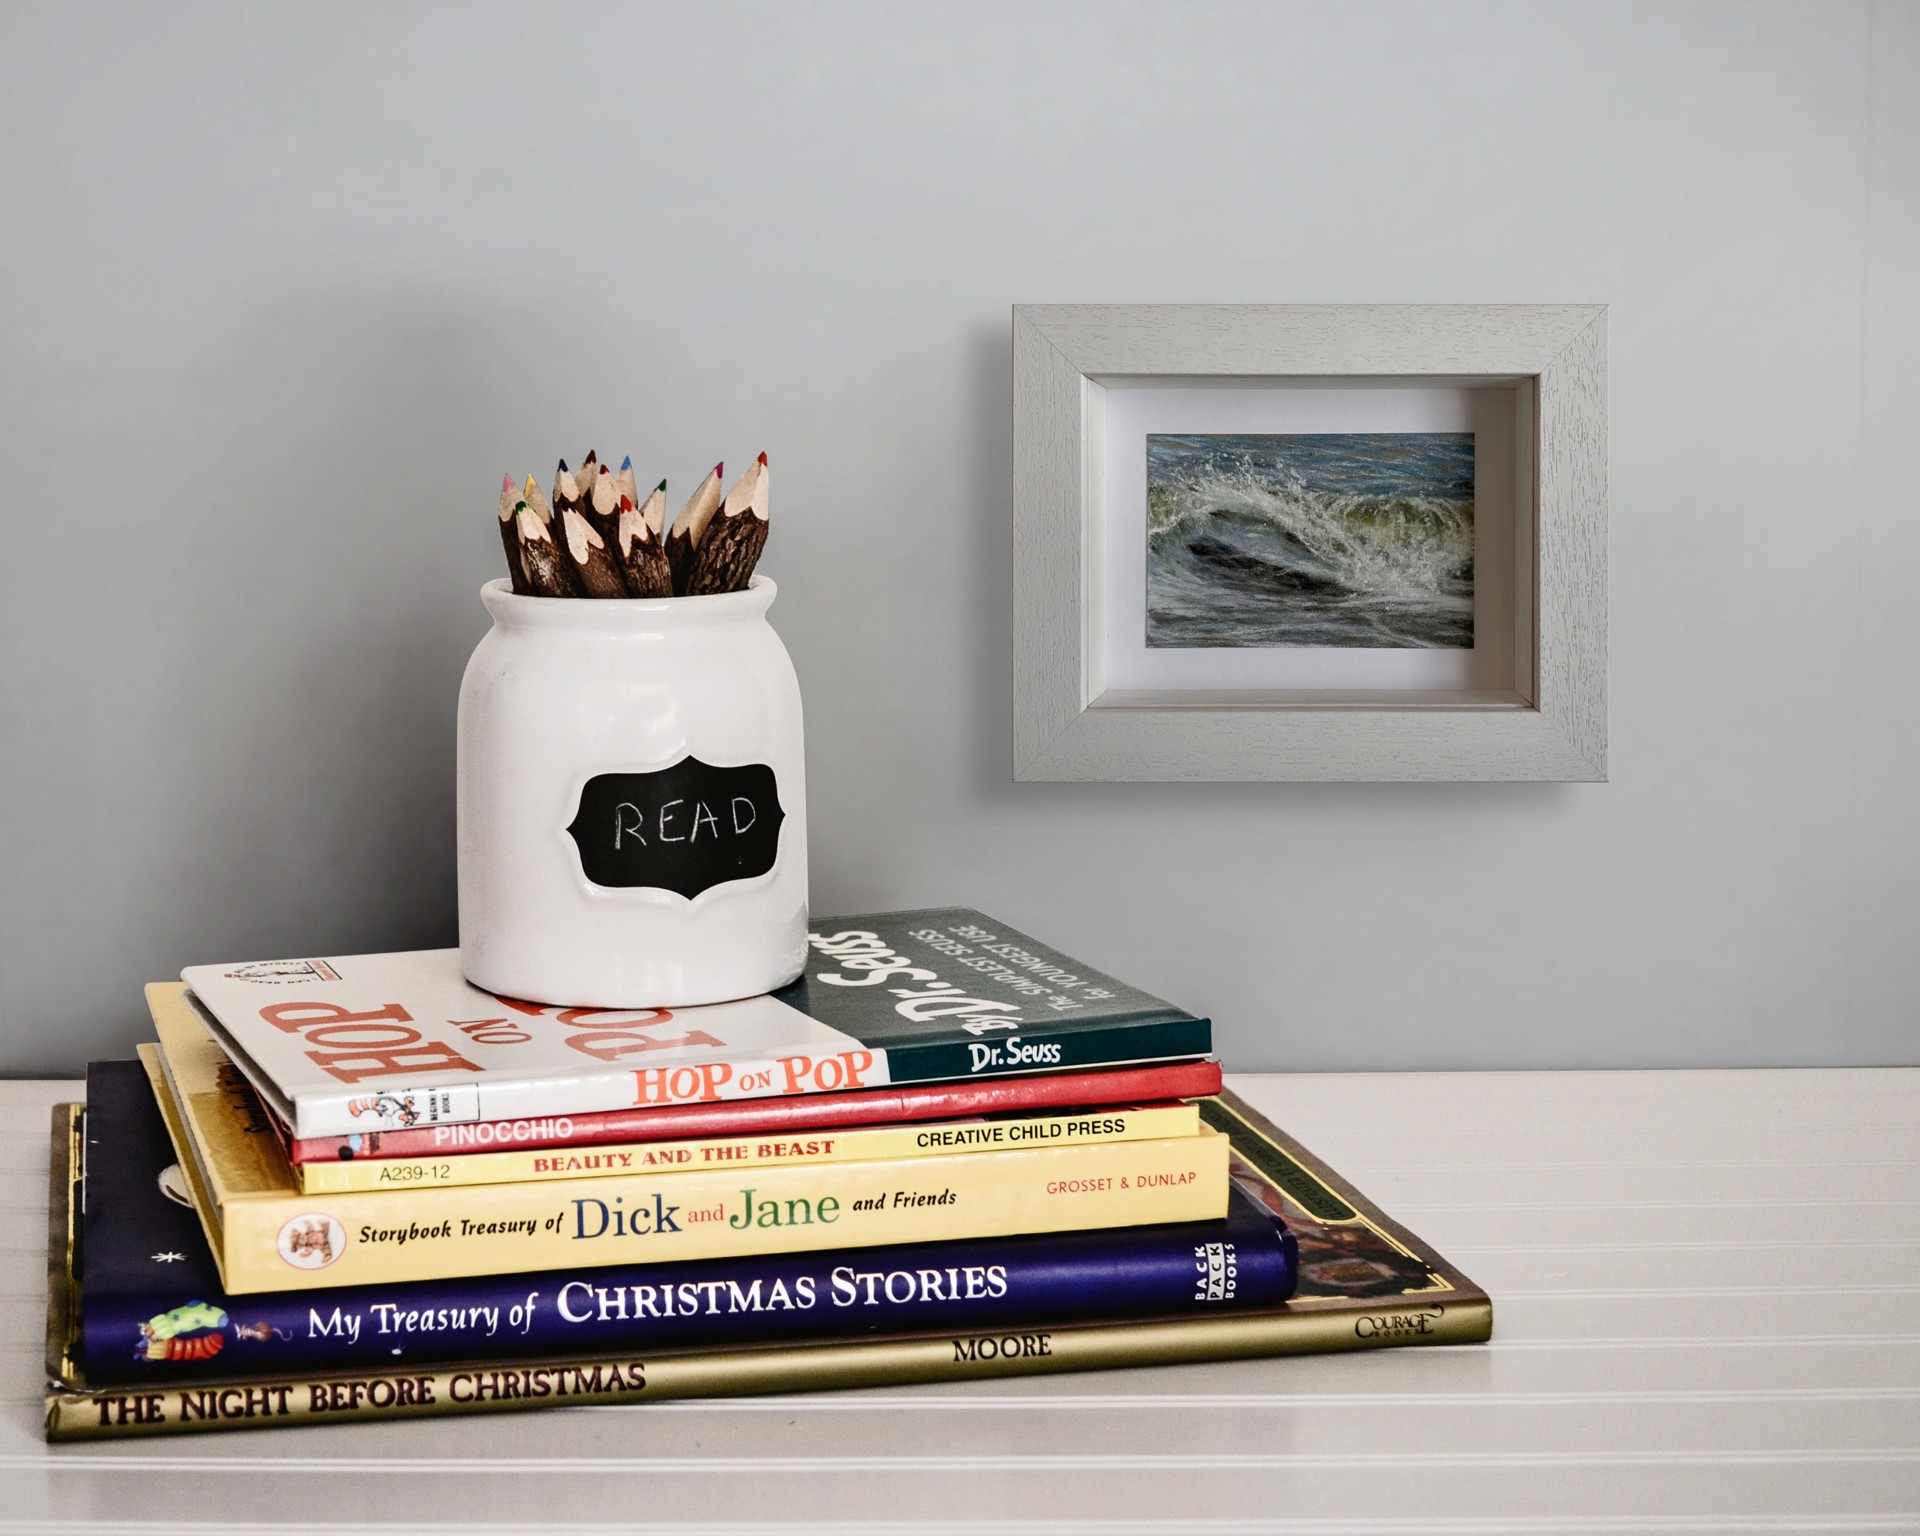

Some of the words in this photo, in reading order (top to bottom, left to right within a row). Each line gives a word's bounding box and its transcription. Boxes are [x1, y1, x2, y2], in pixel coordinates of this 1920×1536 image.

[615, 797, 756, 849] READ
[908, 929, 974, 956] SEUSS
[947, 925, 997, 943] USE
[808, 931, 938, 987] Seuss
[957, 956, 1052, 996] SIMPLEST
[981, 943, 1088, 988] YOUNGEST
[887, 981, 1021, 1023] Dr.
[1047, 995, 1084, 1011] The
[259, 1001, 486, 1084] HOP
[447, 1018, 532, 1044] ON
[494, 994, 727, 1061] PO
[956, 1013, 1023, 1036] By
[968, 1042, 1004, 1072] Dr.
[1005, 1036, 1061, 1065] Seuss
[630, 1063, 733, 1105] HOP
[739, 1069, 772, 1091] ON
[776, 1050, 873, 1094] POP
[434, 1117, 574, 1147] PINOCCHIO
[917, 1127, 1003, 1147] CREATIVE
[1009, 1123, 1062, 1141] CHILD
[1067, 1118, 1125, 1136] PRESS
[380, 1165, 450, 1182] A239-12
[534, 1153, 632, 1173] BEAUTY
[642, 1148, 692, 1165] AND
[701, 1145, 748, 1162] THE
[757, 1140, 836, 1158] BEAST
[1046, 1178, 1113, 1195] GROSSET
[1120, 1177, 1130, 1189] &
[1137, 1172, 1196, 1188] DUNLAP
[359, 1220, 452, 1245] Storybook
[460, 1218, 537, 1236] Treasury
[545, 1212, 564, 1233] of
[571, 1193, 683, 1240] Dick
[688, 1203, 724, 1223] and
[729, 1189, 840, 1231] Jane
[852, 1192, 886, 1212] and
[893, 1188, 957, 1208] Friends
[1194, 1246, 1207, 1300] BACK
[1210, 1246, 1221, 1298] PACK
[1224, 1243, 1237, 1298] BOOKS
[308, 1307, 361, 1344] My
[370, 1303, 499, 1337] Treasury
[509, 1292, 539, 1334] of
[557, 1276, 816, 1323] CHRISTMAS
[831, 1265, 1008, 1307] STORIES
[1355, 1304, 1444, 1338] COURAGE
[952, 1334, 1052, 1361] MOORE
[93, 1394, 165, 1426] THE
[179, 1385, 293, 1421] NIGHT
[308, 1376, 436, 1412] BEFORE
[449, 1363, 646, 1402] CHRISTMAS
